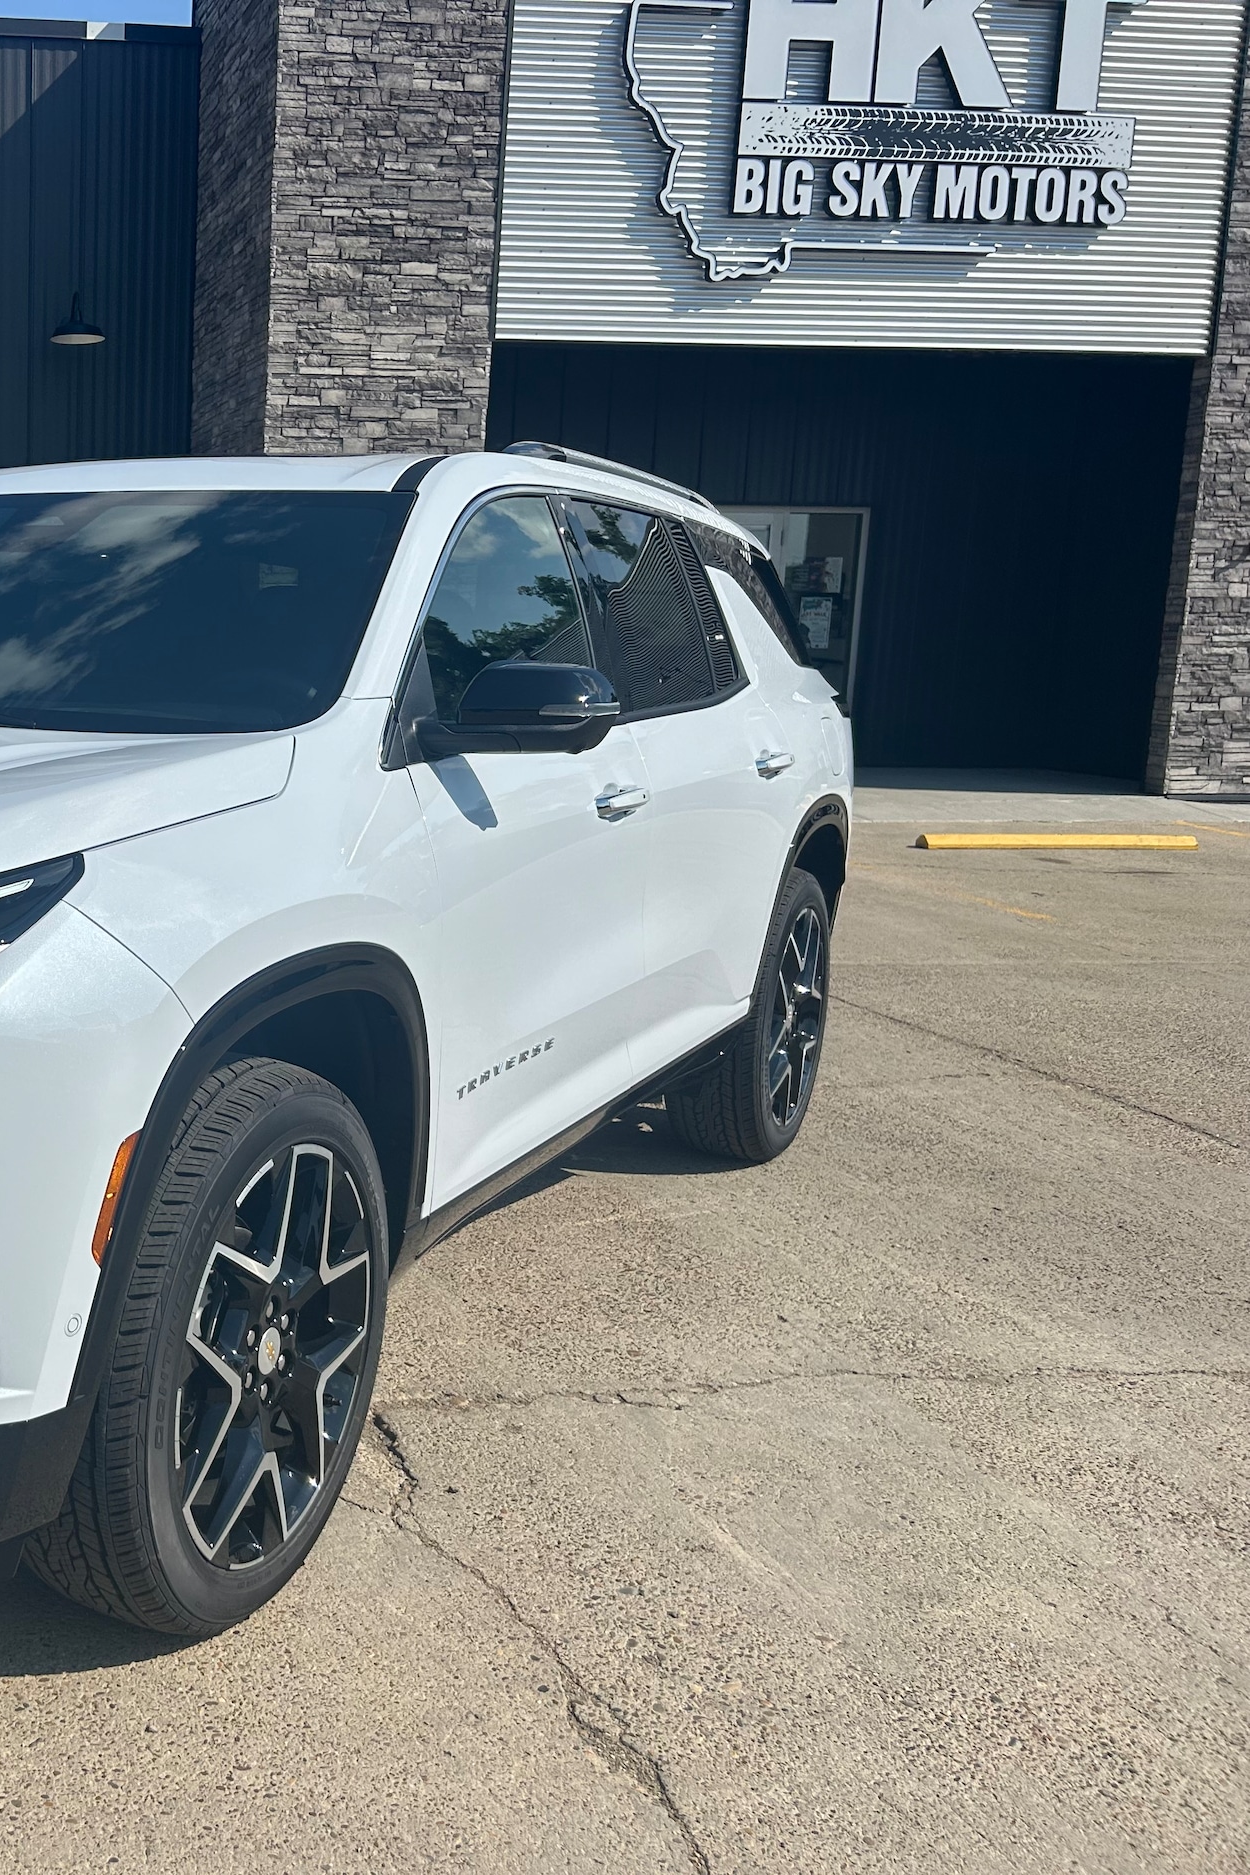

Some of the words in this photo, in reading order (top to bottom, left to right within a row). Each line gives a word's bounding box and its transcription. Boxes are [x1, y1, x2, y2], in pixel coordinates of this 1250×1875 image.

[732, 158, 814, 217] BIG
[827, 160, 926, 219] SKY
[932, 163, 1130, 226] MOTORS
[456, 1037, 555, 1100] TRAVERSE
